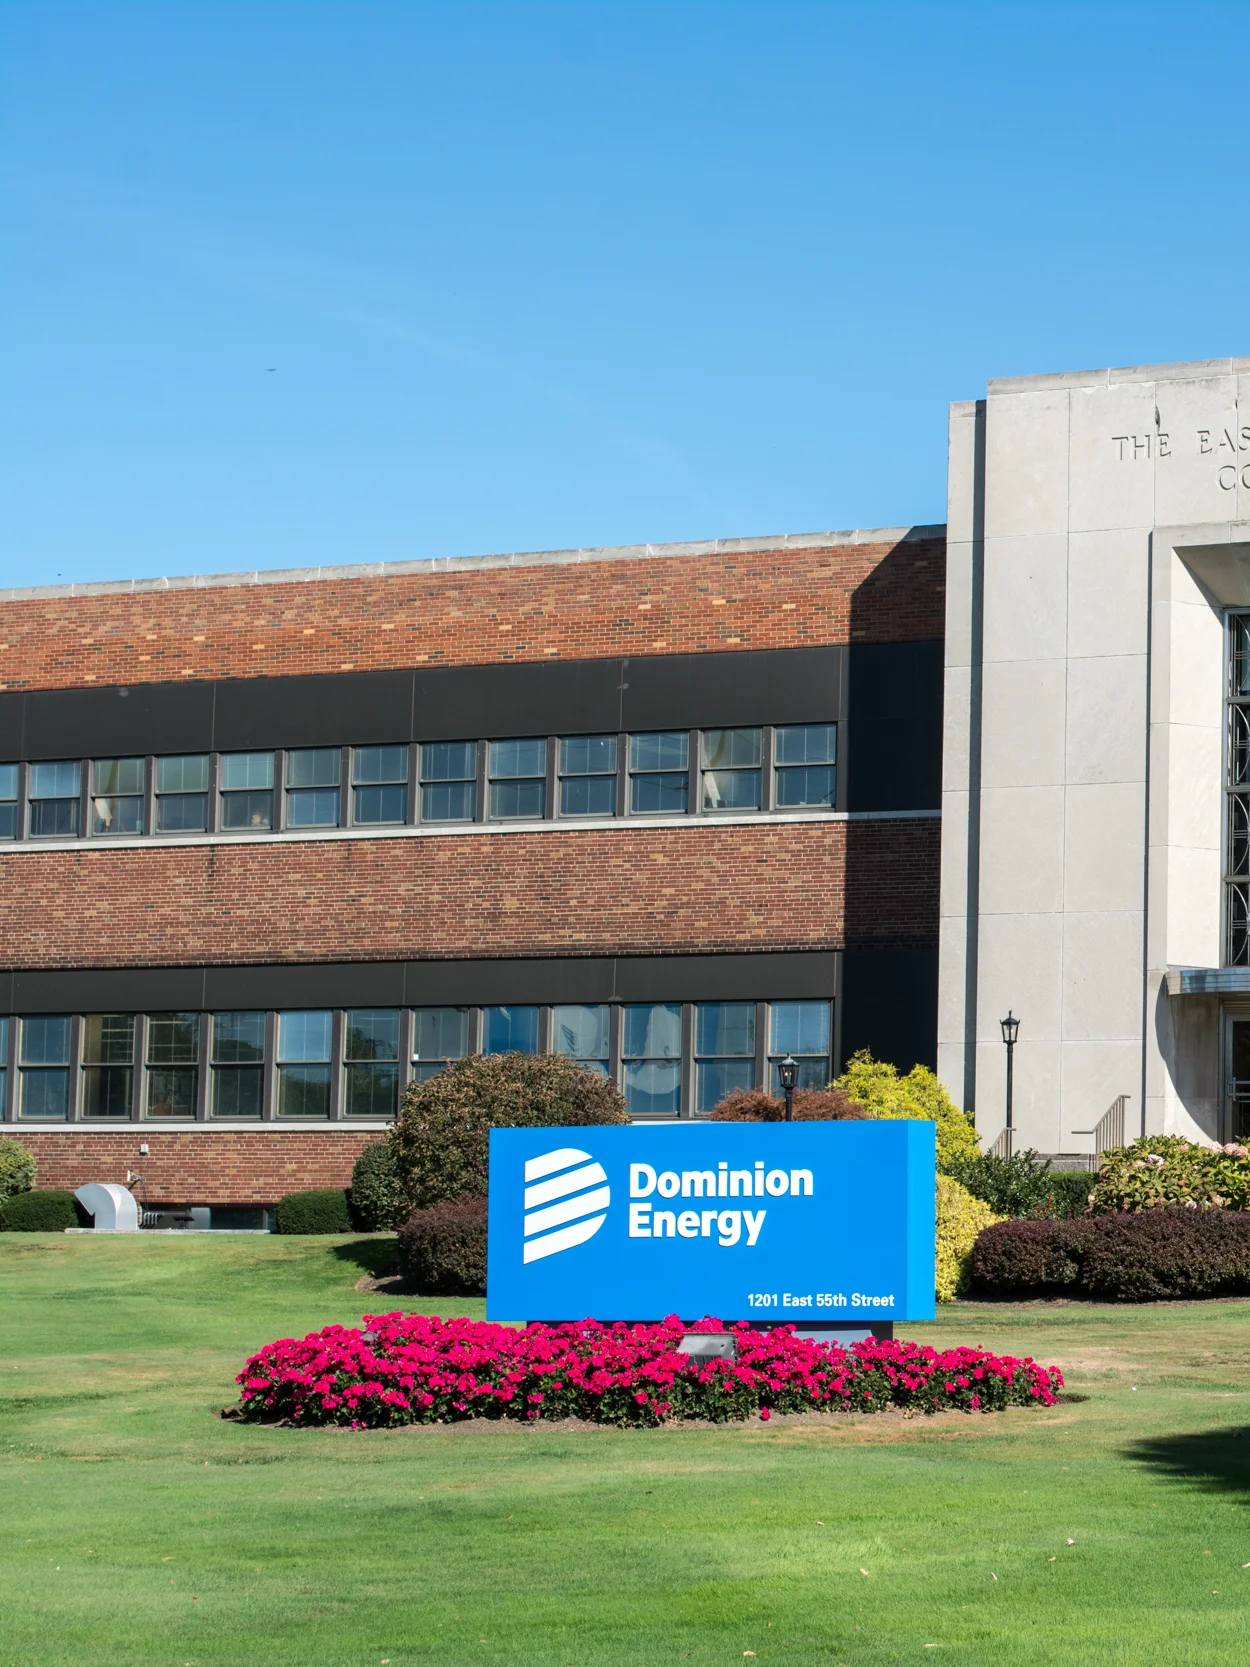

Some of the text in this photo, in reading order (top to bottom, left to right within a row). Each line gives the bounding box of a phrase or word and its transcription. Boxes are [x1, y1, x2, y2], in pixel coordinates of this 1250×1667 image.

[1111, 433, 1172, 461] THE
[629, 1161, 814, 1199] Dominion
[628, 1202, 767, 1247] Energy
[748, 1292, 895, 1307] 1201 East 55th Street
